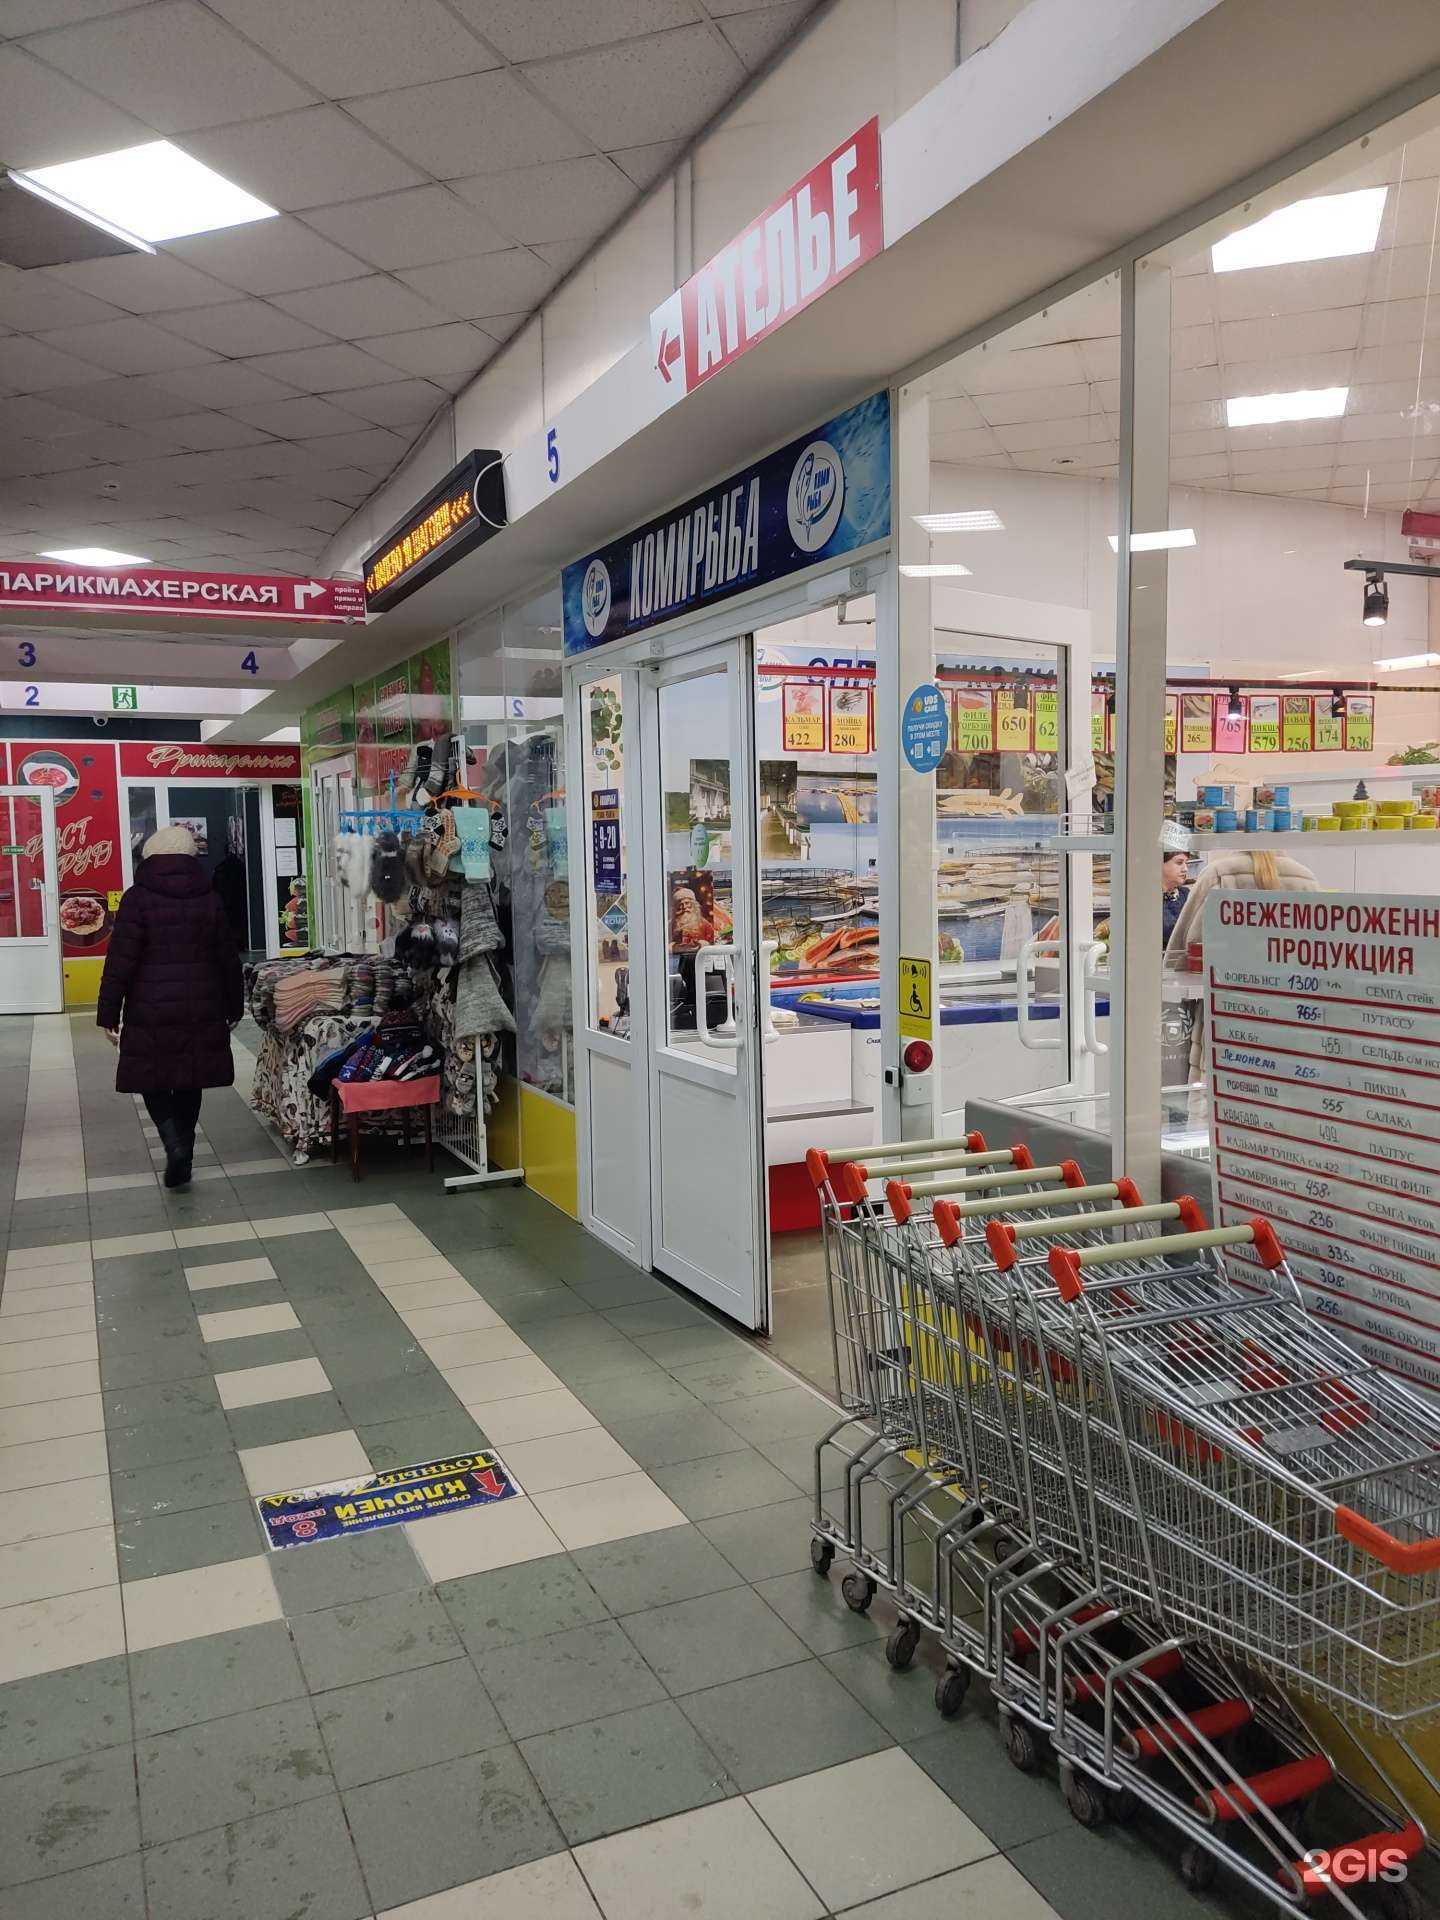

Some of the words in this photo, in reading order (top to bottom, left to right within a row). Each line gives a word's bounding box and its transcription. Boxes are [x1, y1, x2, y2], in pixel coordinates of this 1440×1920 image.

[697, 144, 861, 376] АТЕЛЬЕ
[547, 428, 560, 482] 5
[630, 476, 760, 621] КОМИРЫБА
[18, 642, 37, 668] 3
[241, 651, 259, 674] 4
[25, 686, 40, 706] 2
[1001, 716, 1027, 732] 650
[1219, 718, 1241, 732] 765
[787, 733, 810, 746] 422
[834, 734, 856, 747] 280
[961, 735, 989, 751] 700
[1253, 736, 1277, 750] 579
[1287, 737, 1309, 750] 256
[1318, 730, 1339, 744] 174
[1349, 736, 1370, 750] 236
[599, 826, 617, 850] 9-20
[1219, 900, 1440, 938] СВЕЖЕМОРОЖЕНН
[1267, 937, 1414, 975] ПРОДУКЦИЯ
[1224, 972, 1260, 985] ФОРЕЛЬ
[1288, 975, 1319, 992] 1300
[1366, 986, 1403, 1001] СЕМГА
[1223, 1001, 1256, 1014] ТРЕСКА
[1362, 1013, 1415, 1030] ПУТАССУ
[1228, 1029, 1247, 1041] ХЕК
[1362, 1045, 1404, 1063] СЕЛЬДЬ
[1364, 1081, 1408, 1099] ПИКША
[1366, 1109, 1413, 1130] САЛАКА
[1226, 1135, 1269, 1154] КАЛЬМАР
[1369, 1142, 1417, 1163] ПАЛТУС
[1229, 1163, 1278, 1186] СКУМБРИЯ
[1360, 1168, 1399, 1190] ТУНЕЦ
[1400, 1179, 1432, 1196] ФИЛЕ
[1309, 1209, 1334, 1229] 236
[1367, 1201, 1405, 1222] СЕМГА
[1360, 1228, 1390, 1246] ФИЛЕ
[1391, 1238, 1436, 1262] ПИКШИ
[1368, 1263, 1407, 1284] ОКУНЬ
[1364, 1318, 1394, 1339] ФИЛЕ
[1360, 1343, 1391, 1362] ФИЛЕ
[334, 1479, 468, 1521] КЛЮЧЕЙ
[427, 1493, 472, 1509] СРОЧНОЕ
[342, 1504, 424, 1528] ИЗГОТОВЛЕНИЕ
[292, 1520, 318, 1538] 8
